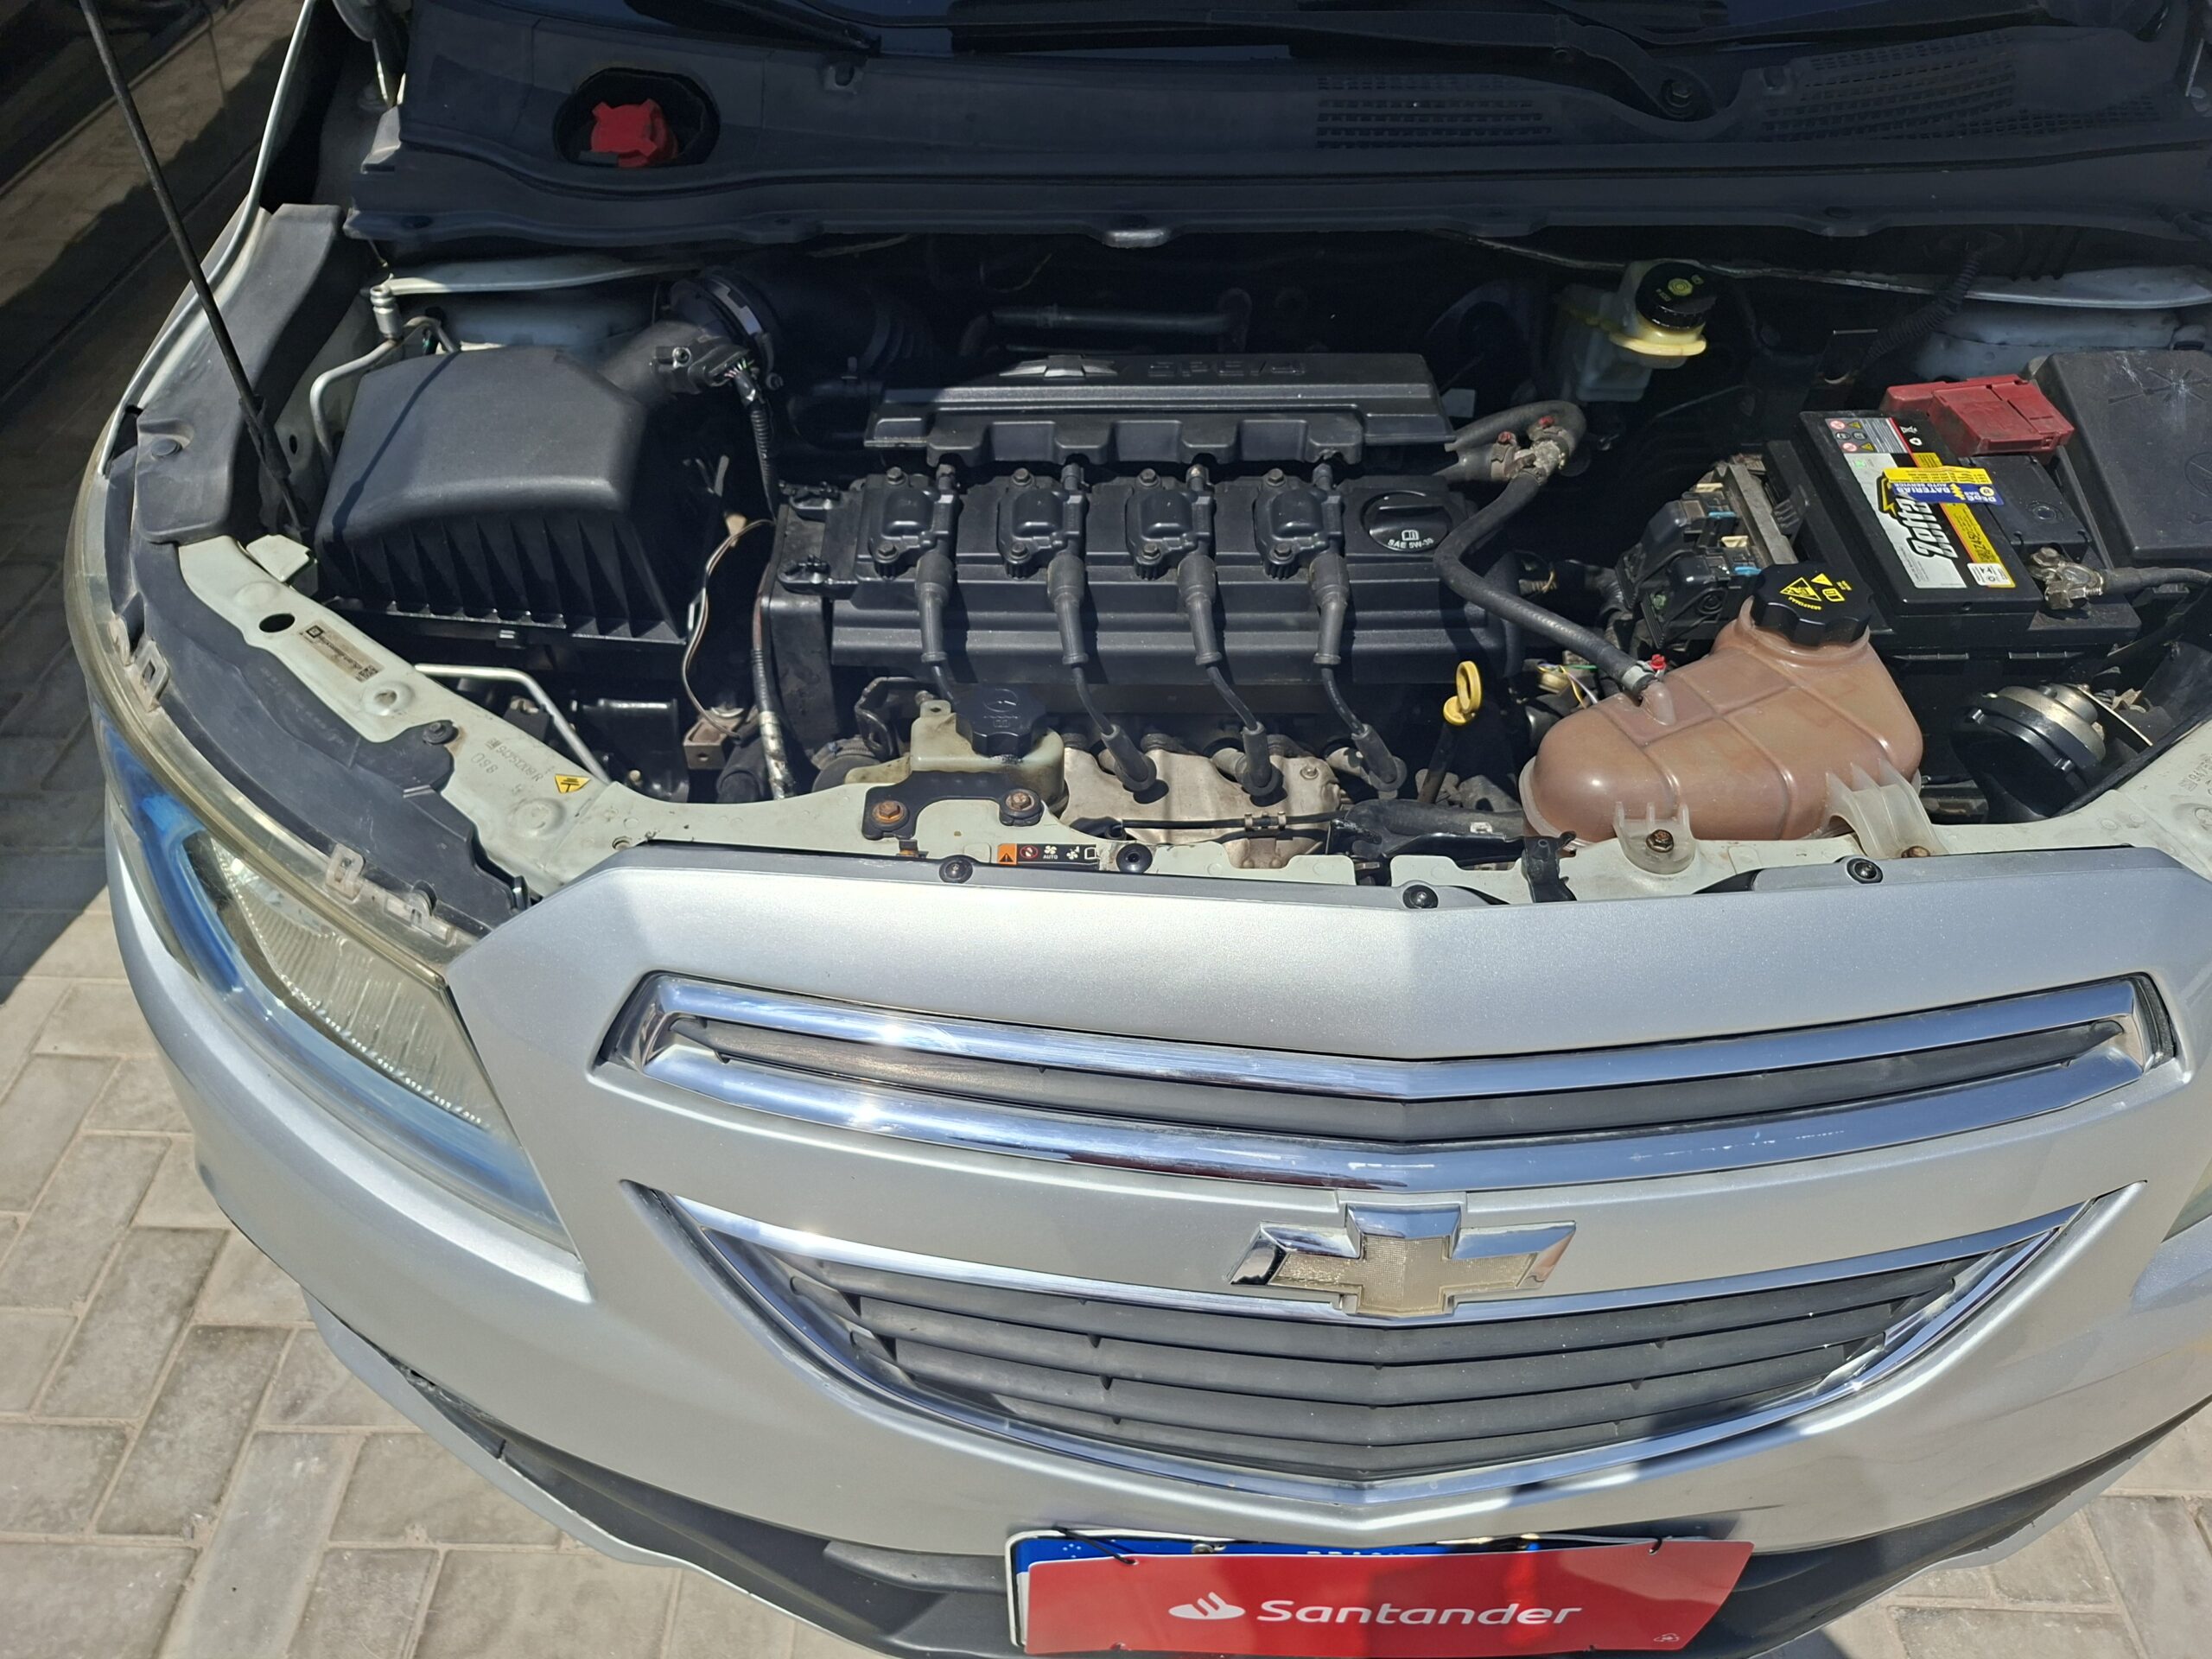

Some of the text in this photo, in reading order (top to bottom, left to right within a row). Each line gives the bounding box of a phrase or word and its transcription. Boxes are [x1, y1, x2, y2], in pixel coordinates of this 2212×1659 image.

[1896, 498, 1955, 558] Zetta
[1387, 538, 1407, 549] SAE
[1256, 1599, 1583, 1625] Santander
